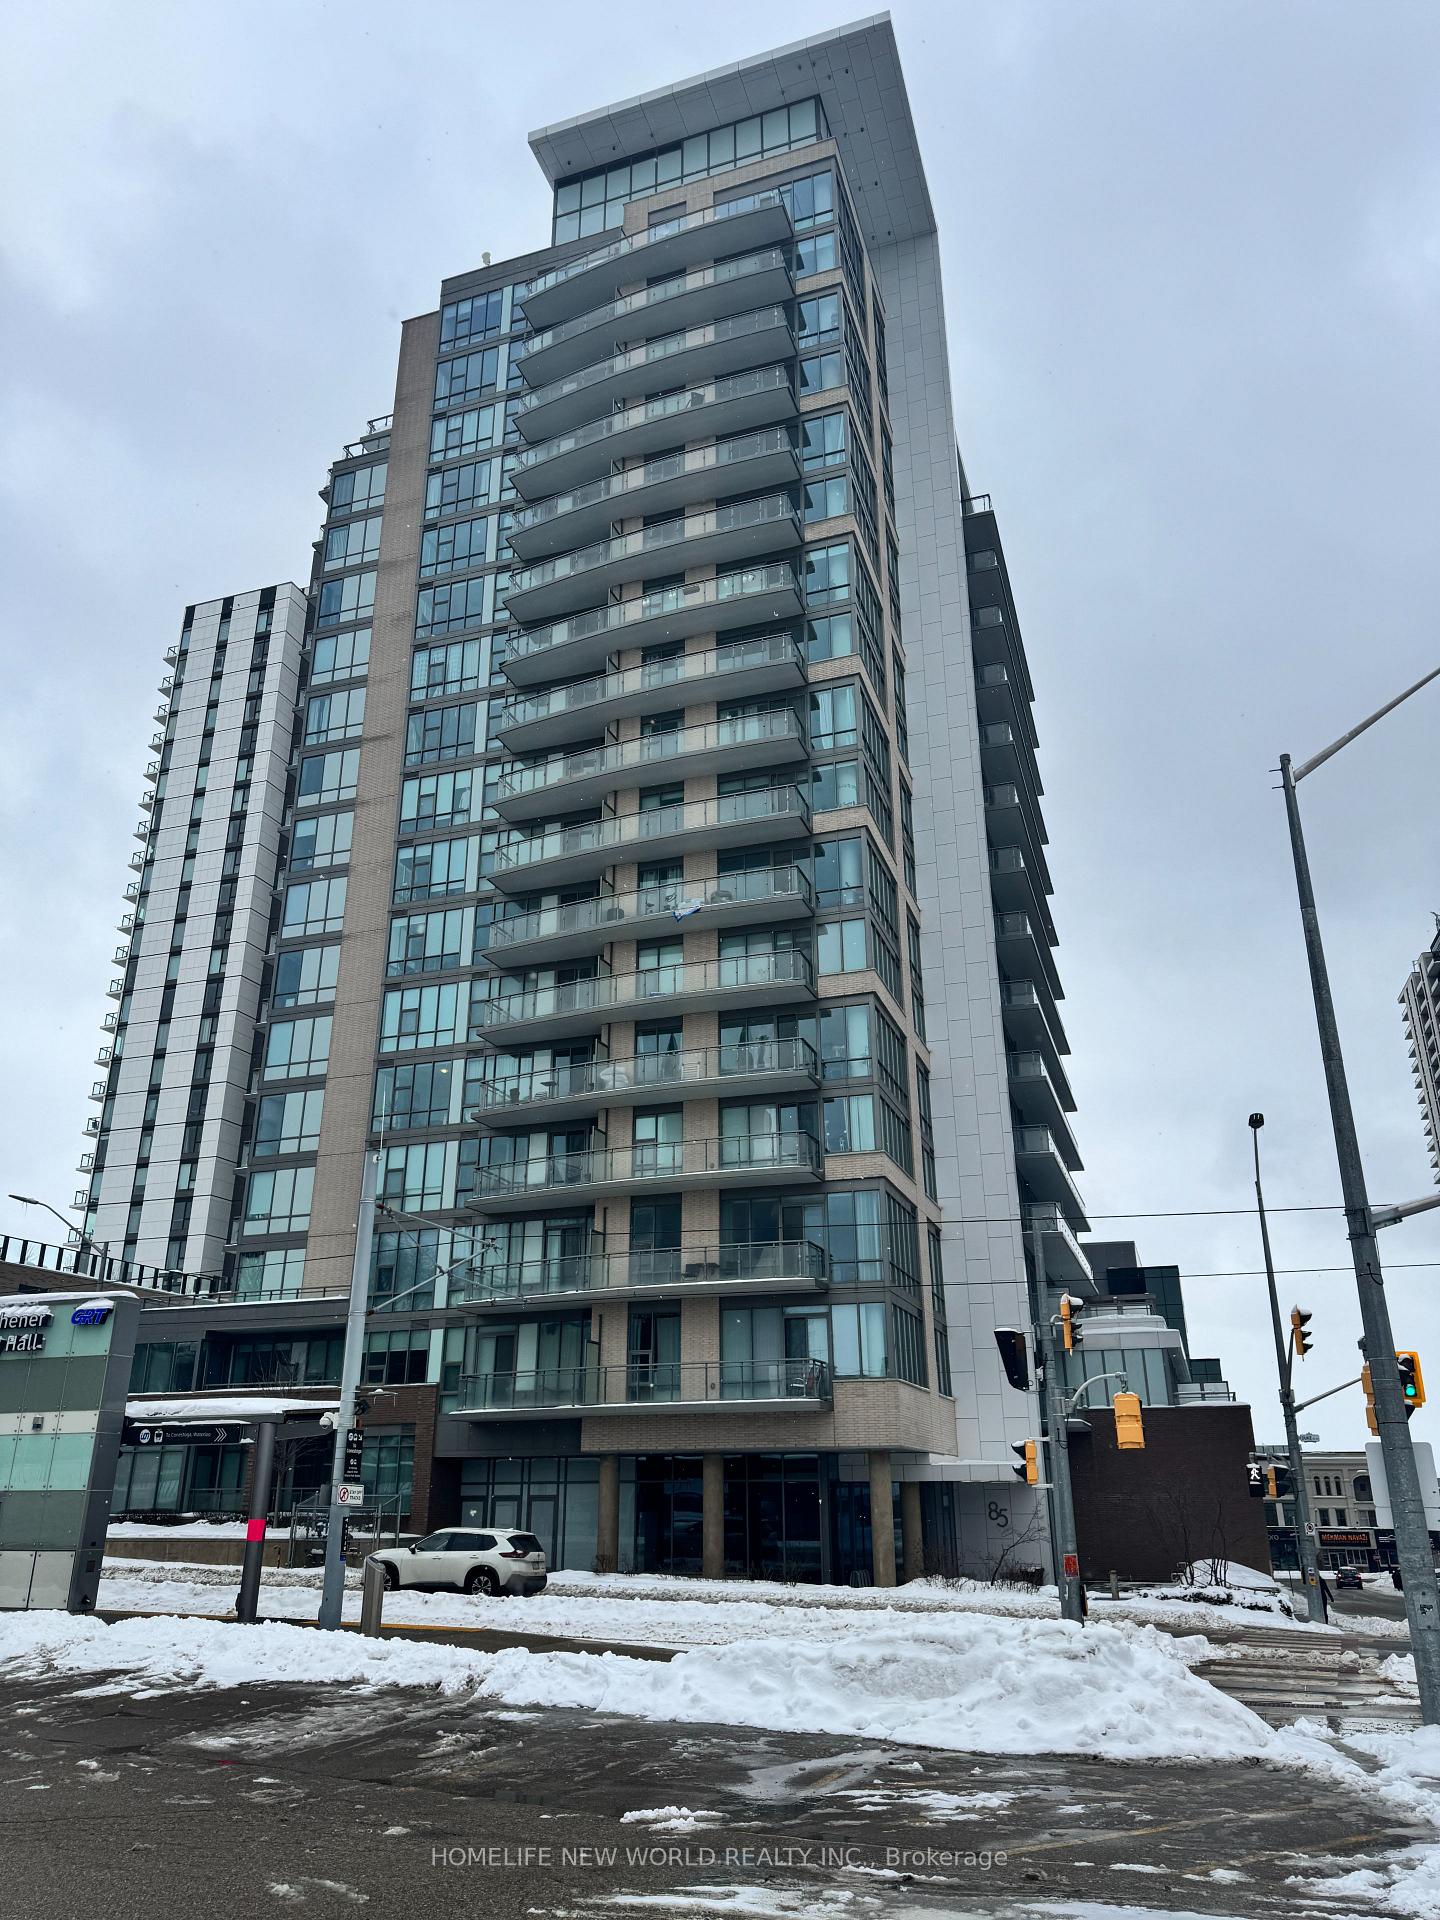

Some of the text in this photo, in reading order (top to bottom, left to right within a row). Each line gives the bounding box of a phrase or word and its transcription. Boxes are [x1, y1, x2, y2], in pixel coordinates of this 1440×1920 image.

[71, 1309, 107, 1326] GRT
[5, 1333, 38, 1352] Hall
[988, 1501, 1009, 1528] 85
